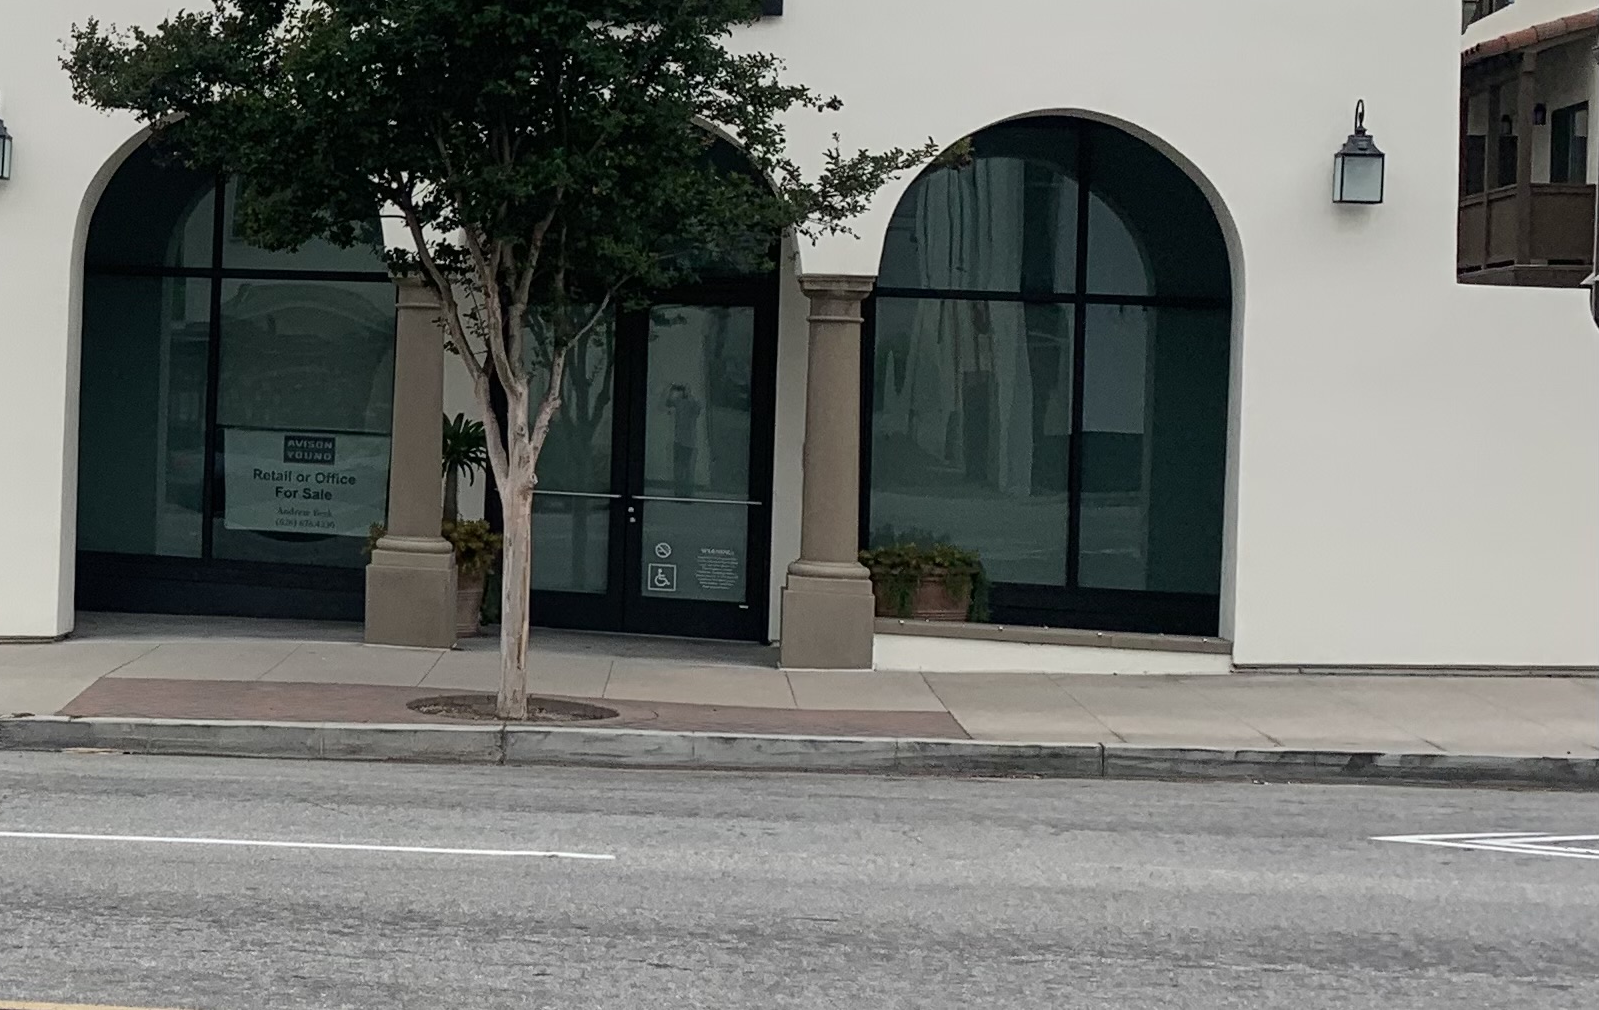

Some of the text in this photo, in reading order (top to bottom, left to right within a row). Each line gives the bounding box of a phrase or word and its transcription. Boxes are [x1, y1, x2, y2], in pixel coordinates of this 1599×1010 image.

[287, 439, 333, 449] AVISON
[253, 468, 357, 486] Retail or Office
[275, 486, 333, 501] For Sale
